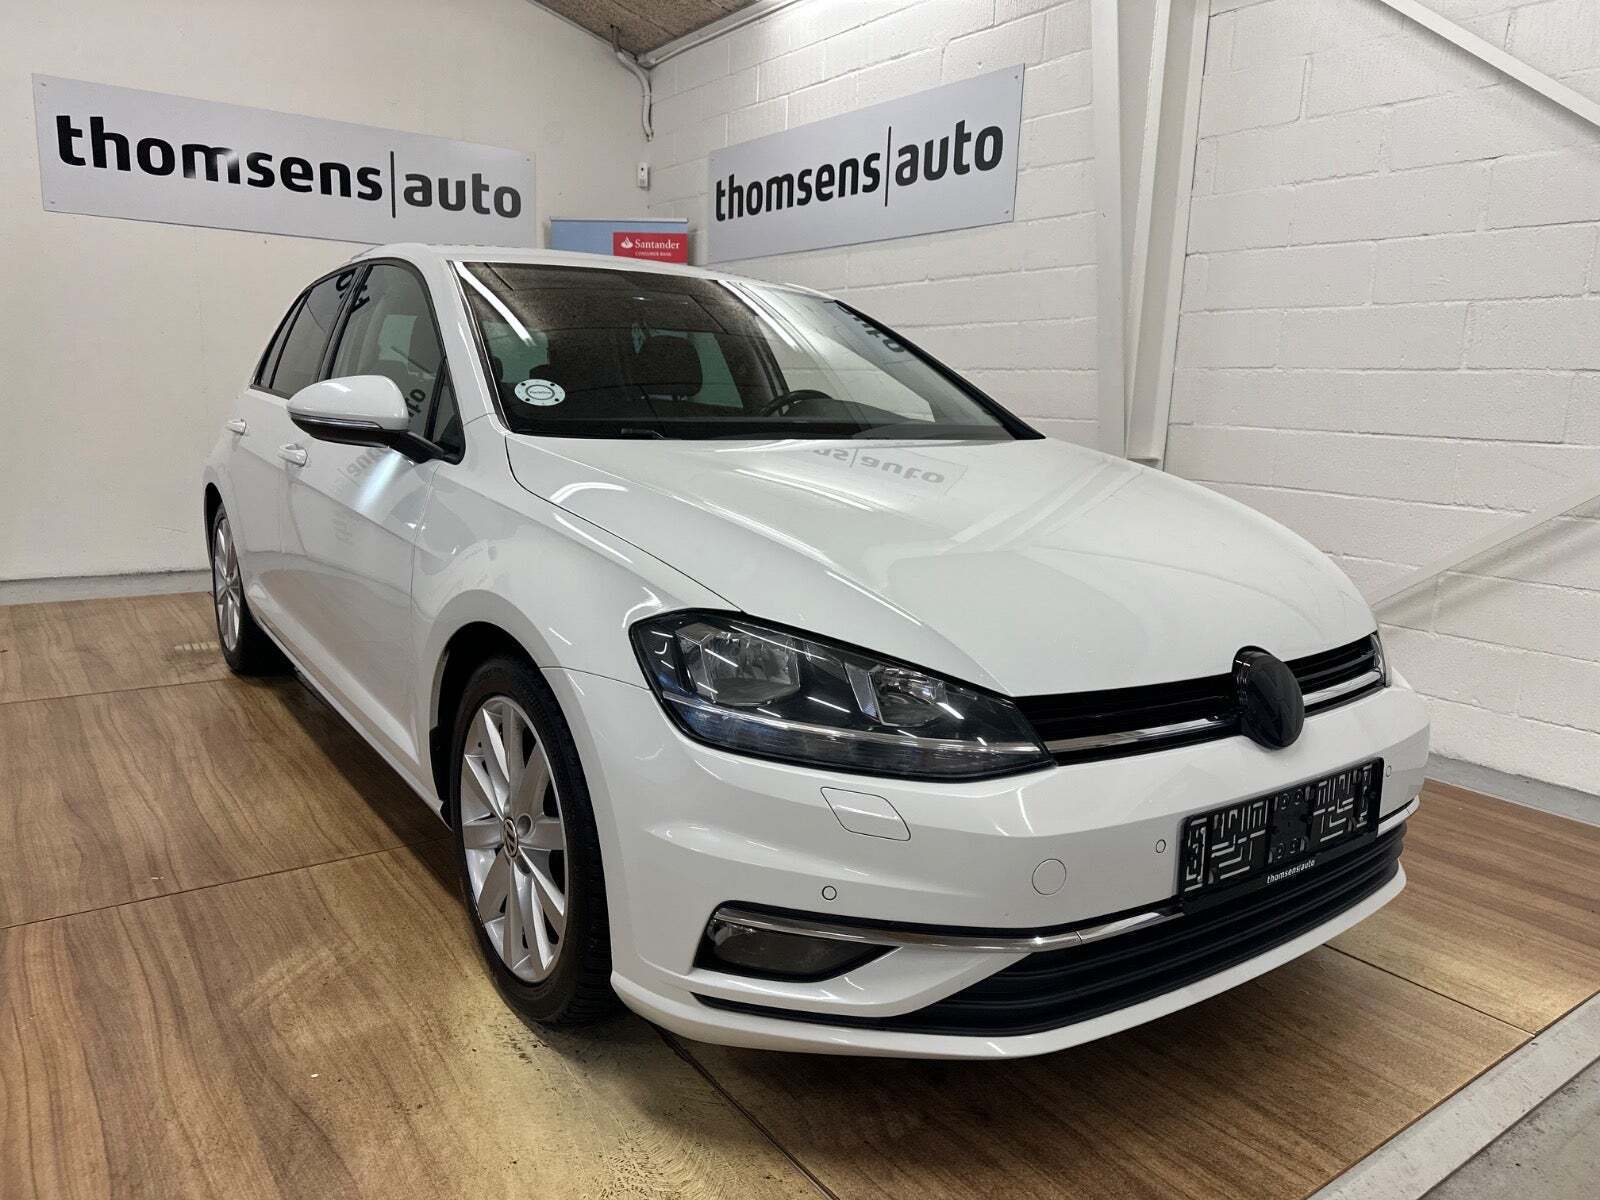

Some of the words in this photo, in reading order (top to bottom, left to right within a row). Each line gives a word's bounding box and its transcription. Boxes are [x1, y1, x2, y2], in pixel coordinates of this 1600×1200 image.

[56, 114, 383, 202] thomsens
[403, 173, 523, 219] auto
[715, 152, 881, 223] thomsens
[895, 119, 1004, 188] auto
[635, 239, 680, 249] Santander
